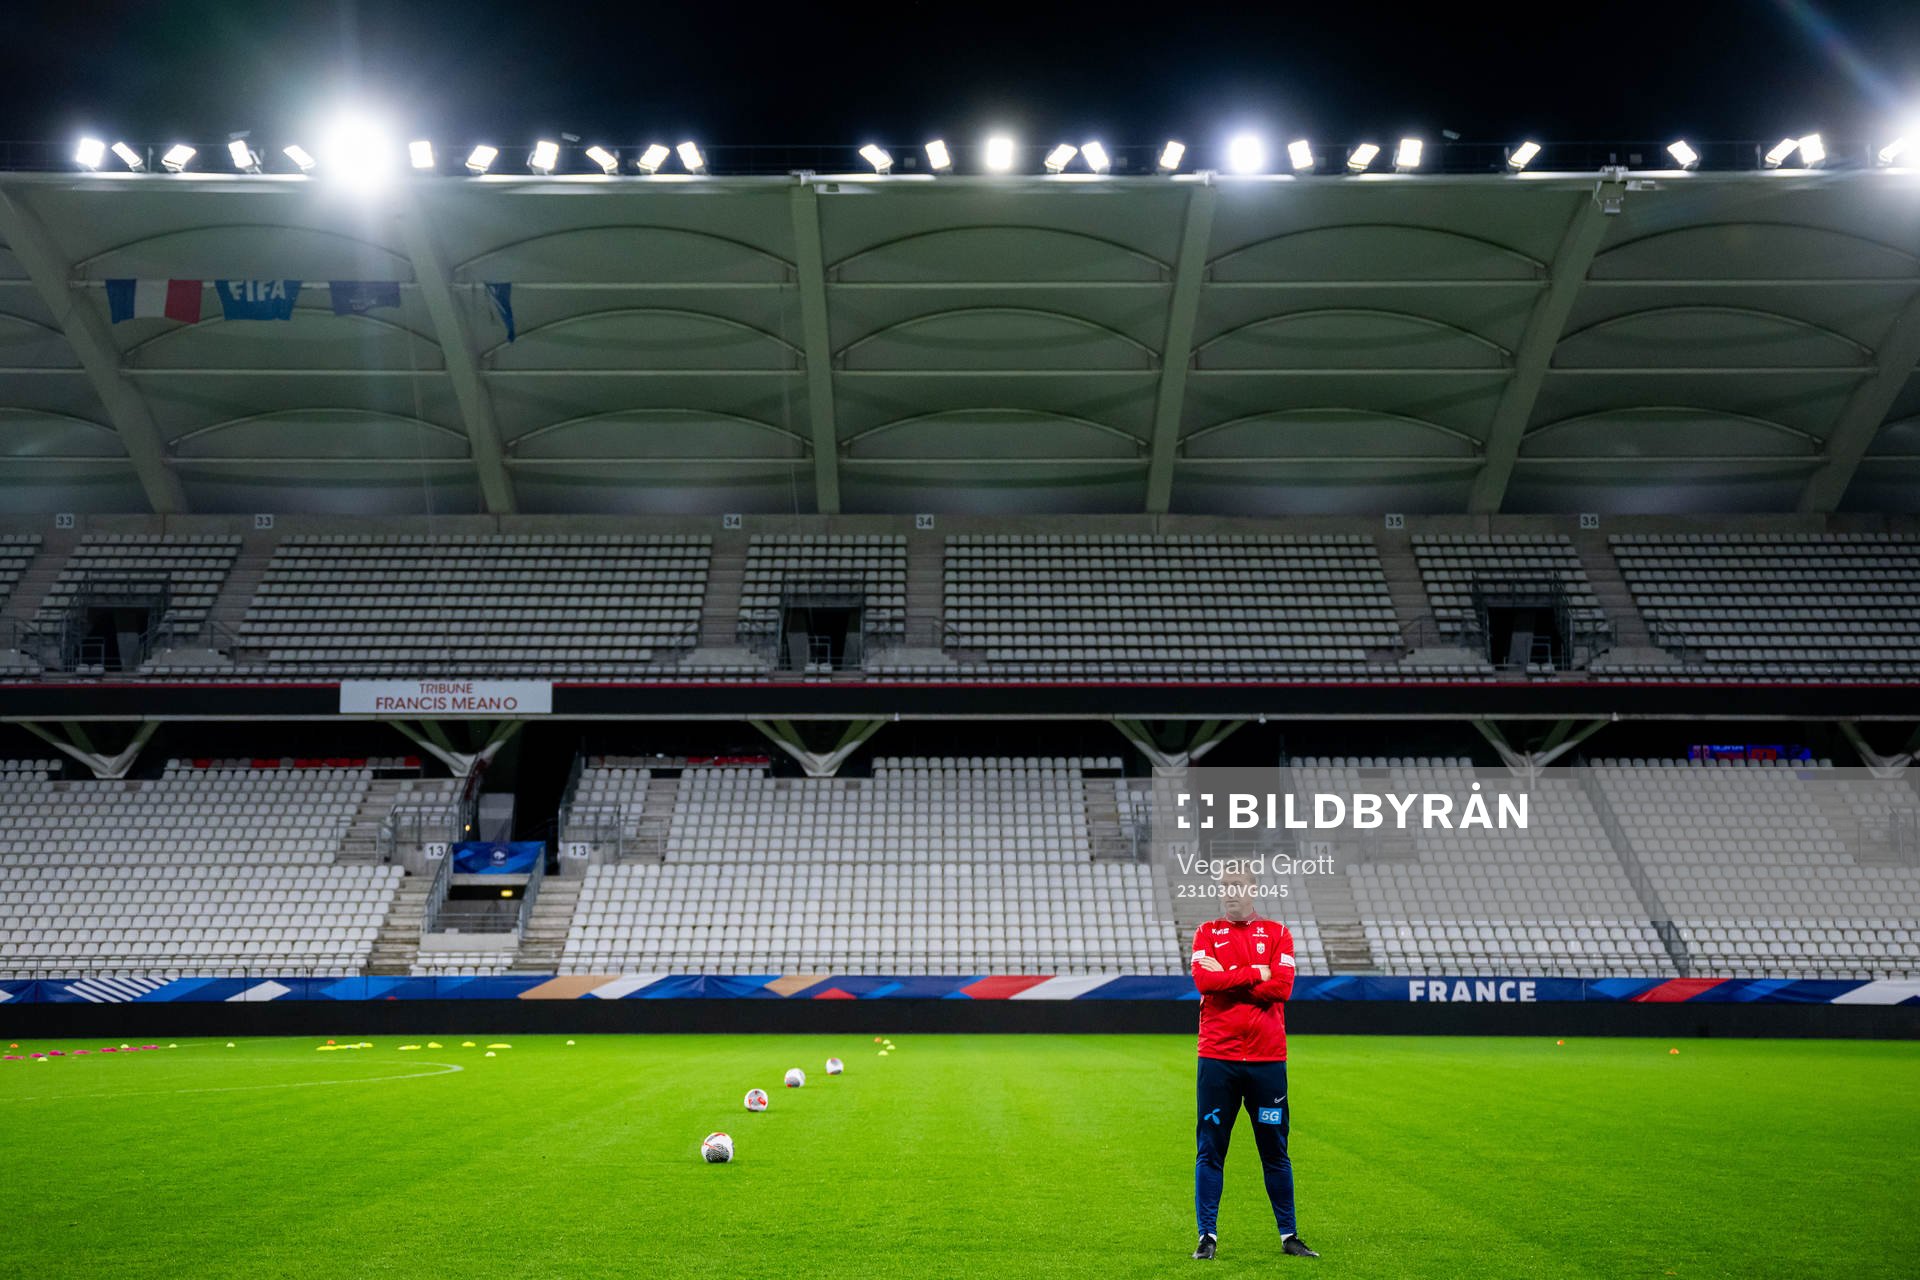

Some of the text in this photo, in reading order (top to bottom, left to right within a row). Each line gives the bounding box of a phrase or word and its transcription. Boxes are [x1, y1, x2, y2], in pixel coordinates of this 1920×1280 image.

[228, 280, 286, 301] FIFA
[57, 515, 73, 526] 33
[256, 515, 272, 527] 33
[725, 516, 740, 527] 34
[918, 516, 933, 527] 34
[1387, 516, 1402, 527] 35
[1582, 515, 1597, 526] 35
[419, 683, 473, 694] TRIBUNE
[375, 696, 447, 710] FRANCIS
[428, 846, 444, 856] 13
[572, 845, 587, 856] 13
[1313, 845, 1328, 855] 14
[1408, 980, 1537, 1002] FRANCE
[1261, 1110, 1280, 1121] 5G
